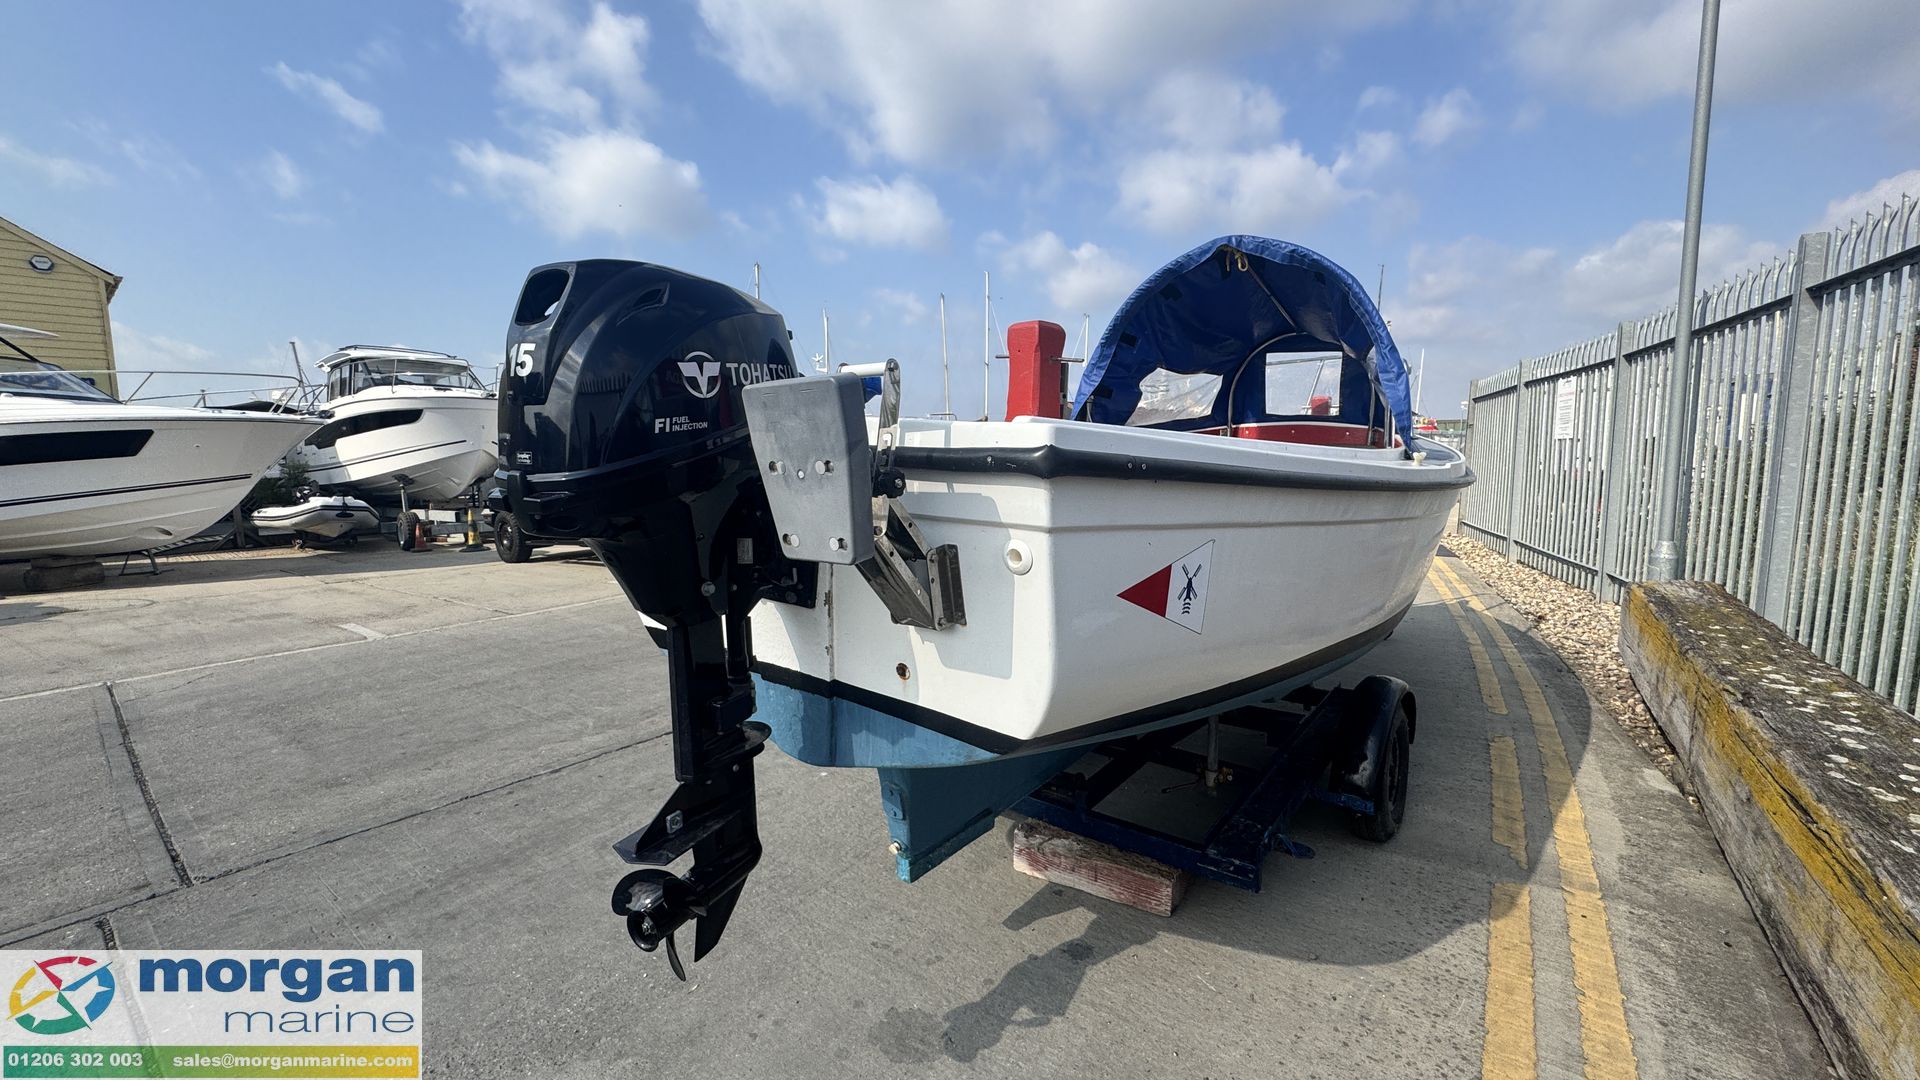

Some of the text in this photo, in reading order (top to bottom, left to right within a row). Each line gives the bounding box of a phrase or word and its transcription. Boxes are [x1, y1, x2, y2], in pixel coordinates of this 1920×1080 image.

[509, 343, 536, 377] 15
[655, 417, 670, 434] FI
[672, 421, 708, 432] INJECTION
